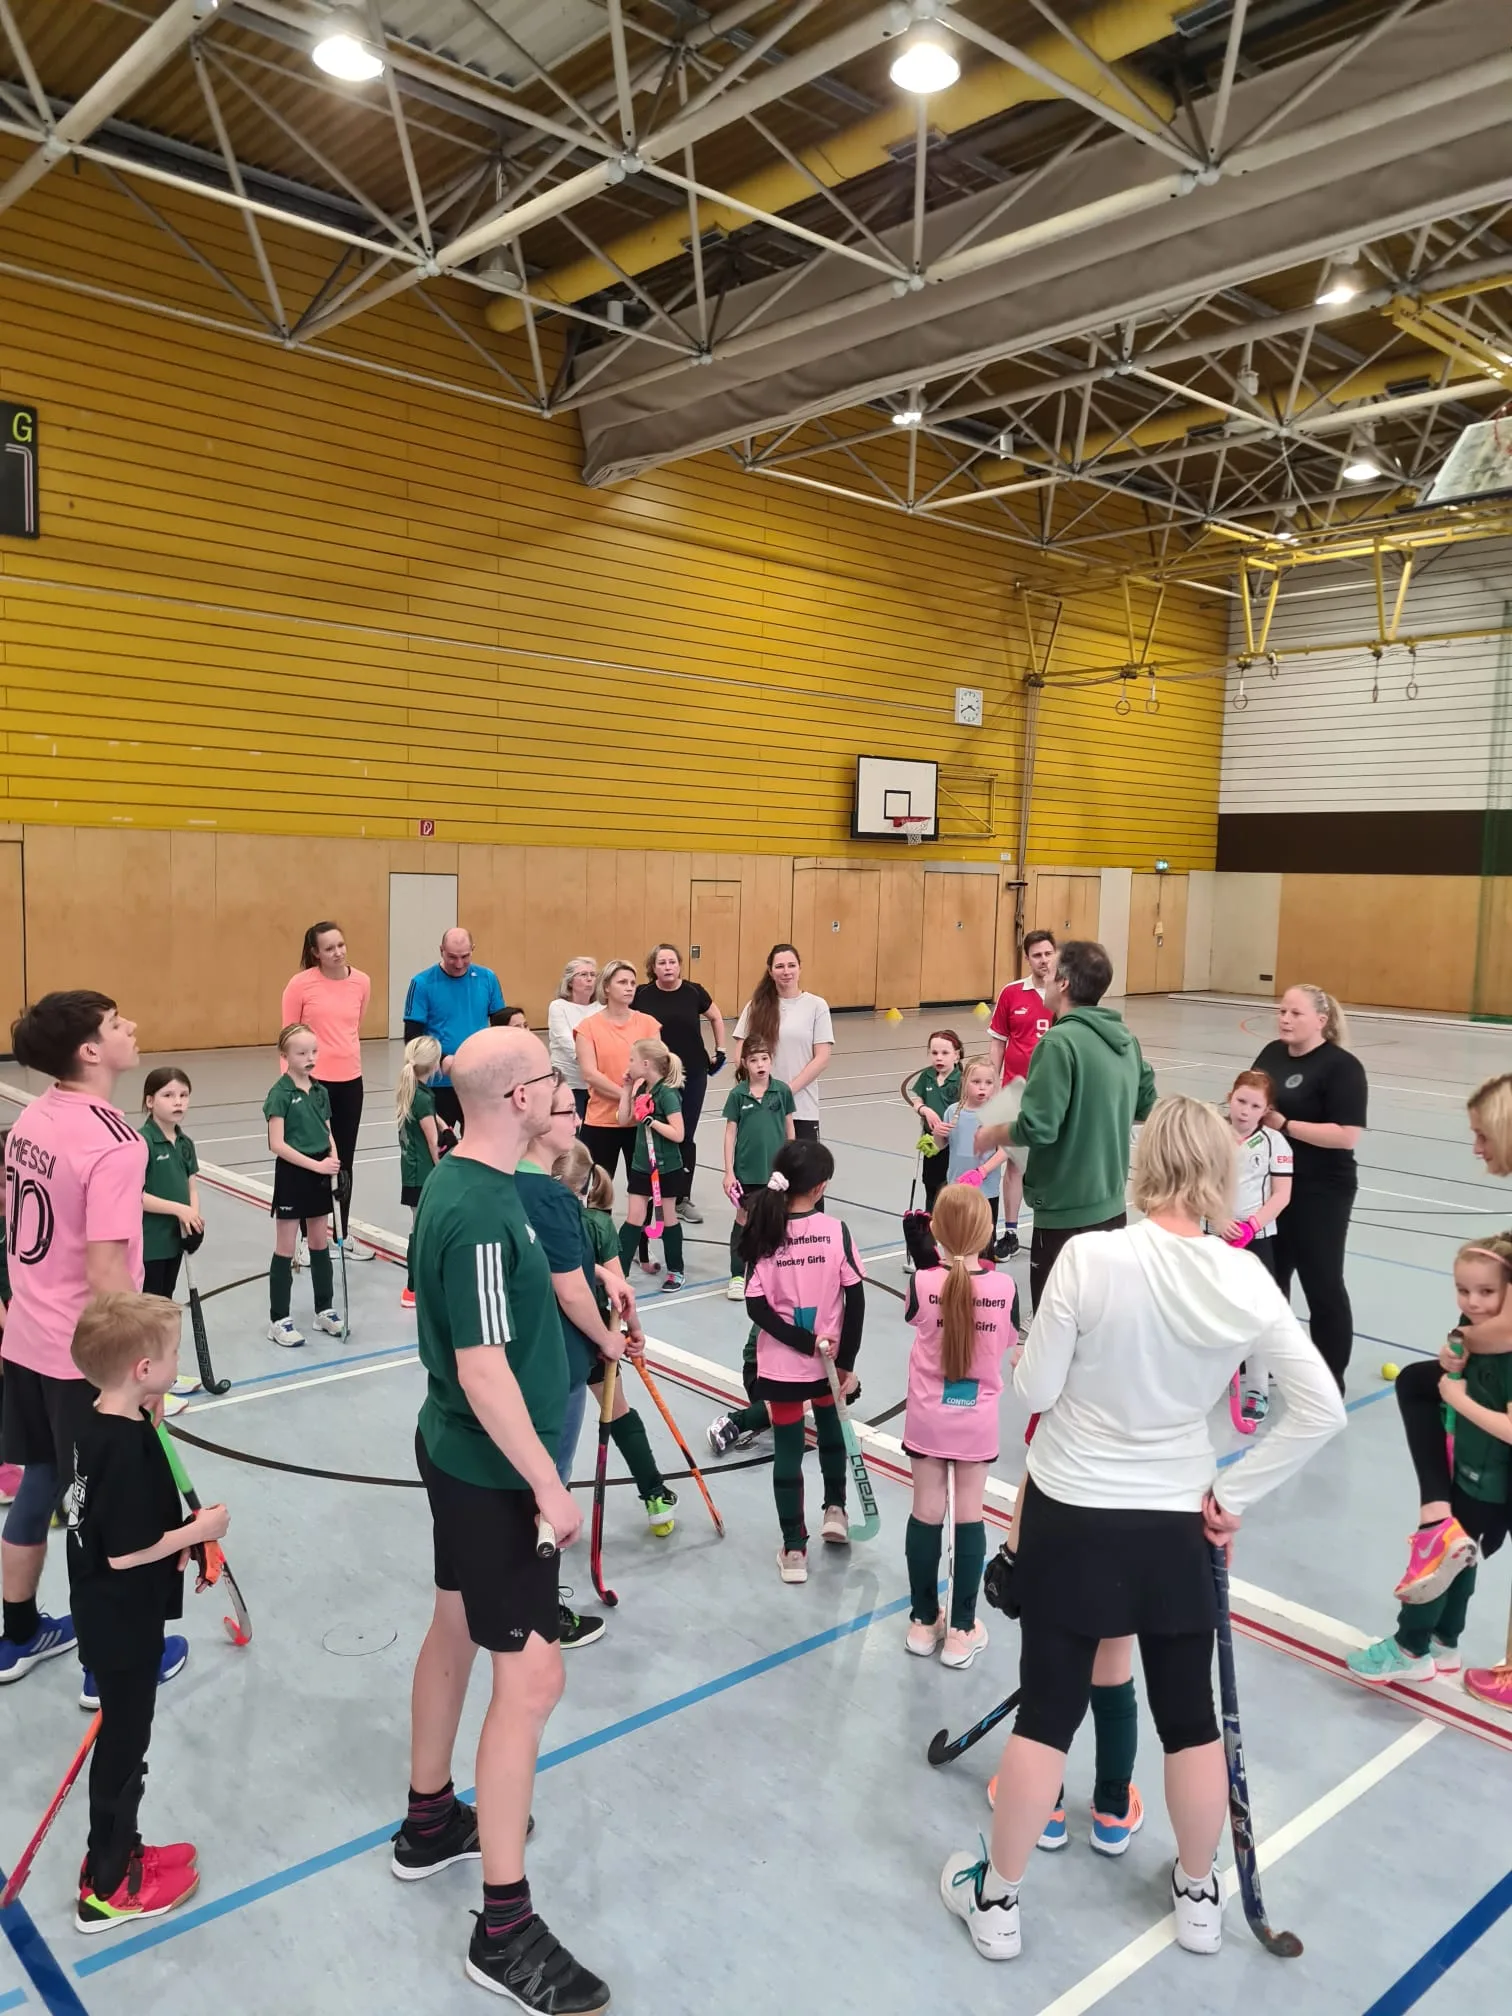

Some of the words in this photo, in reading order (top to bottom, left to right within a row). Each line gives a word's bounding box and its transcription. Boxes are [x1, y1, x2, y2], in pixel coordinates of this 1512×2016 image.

[12, 411, 33, 442] G
[1036, 1019, 1049, 1038] 9
[9, 1134, 57, 1180] MESSI
[6, 1166, 55, 1265] 10
[776, 1257, 805, 1268] Hockey
[807, 1255, 826, 1264] Girls
[975, 1321, 997, 1332] Girls
